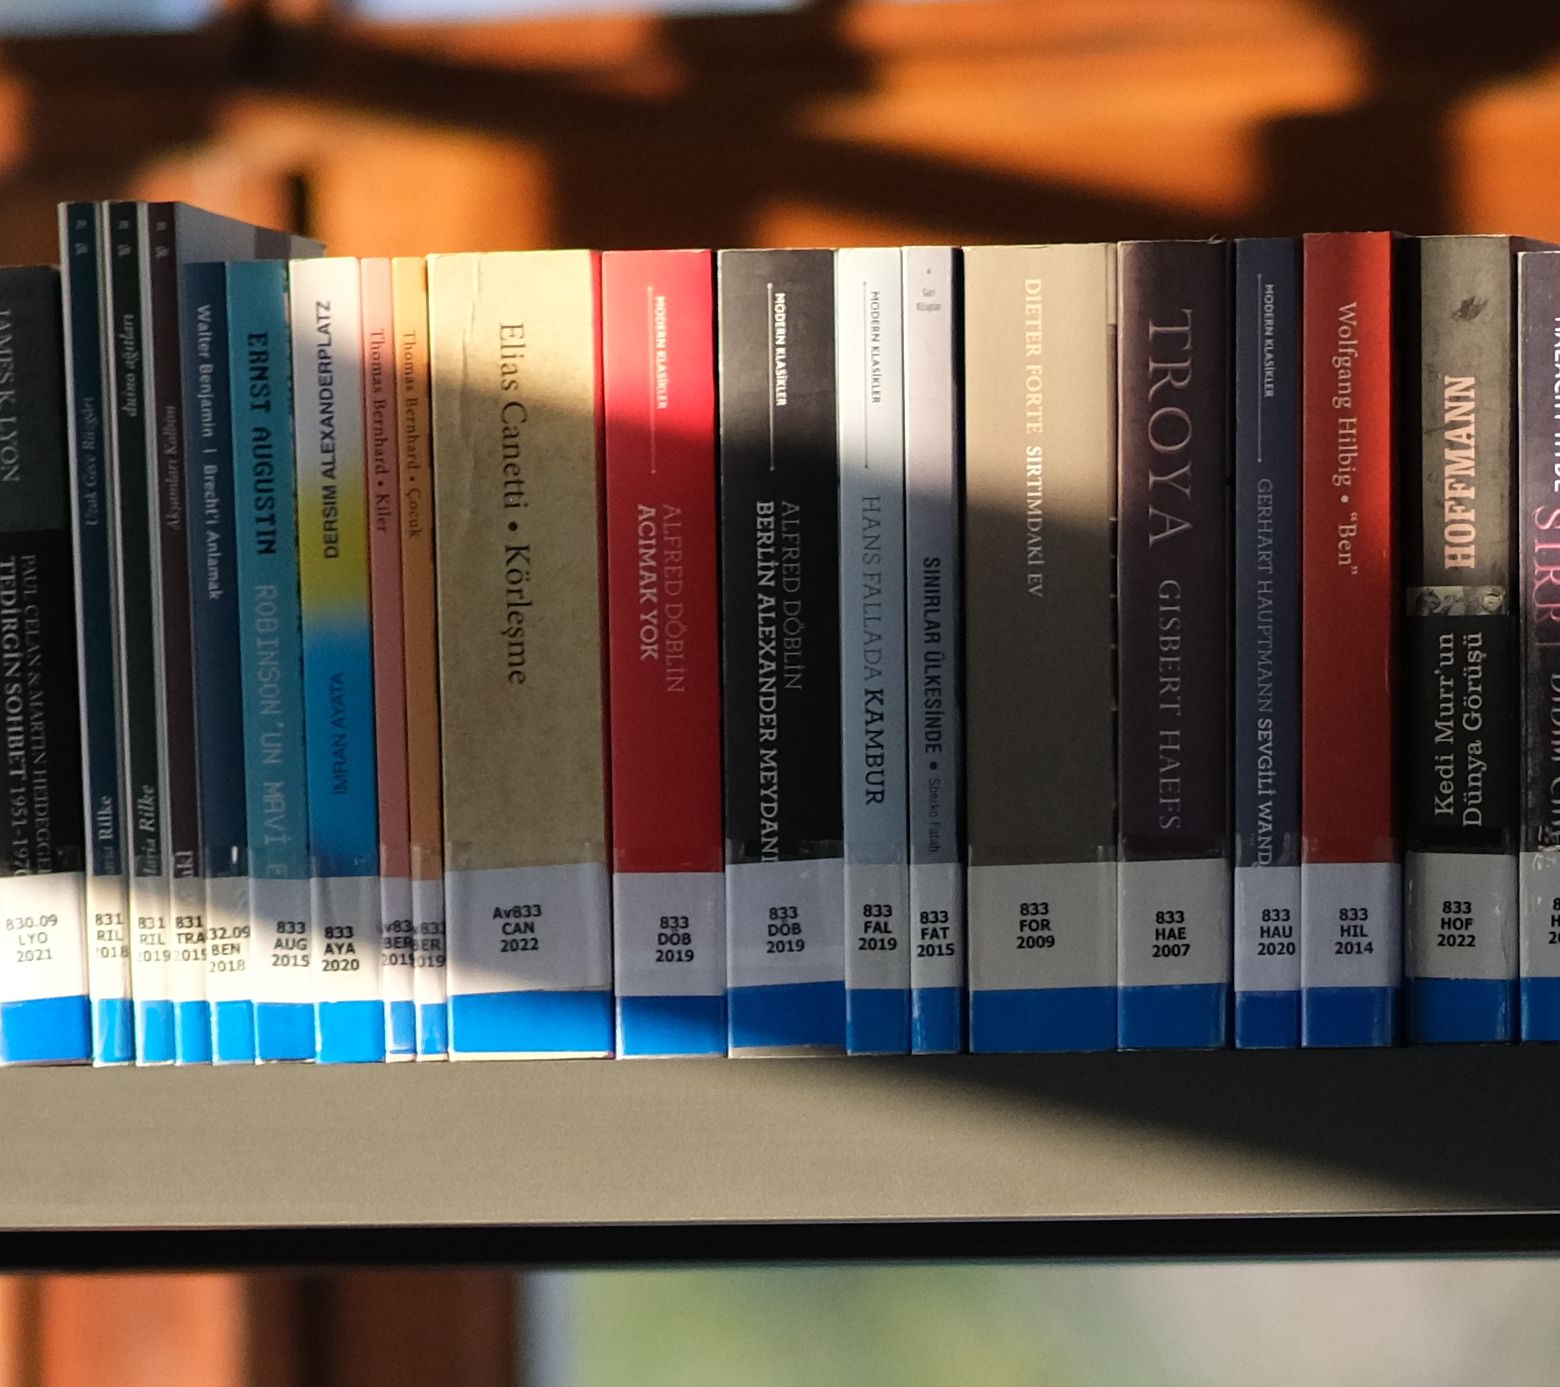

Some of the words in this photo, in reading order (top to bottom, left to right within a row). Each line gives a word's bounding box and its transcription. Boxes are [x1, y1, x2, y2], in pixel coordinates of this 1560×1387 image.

[499, 322, 526, 391] Elias
[1333, 302, 1358, 409] Wolfgang
[500, 401, 528, 511] Canetti
[1146, 308, 1195, 550] TROYA
[1333, 417, 1359, 487] Hilbig
[1444, 374, 1476, 569] HOFFMANN
[637, 504, 659, 605] ACIMAK
[661, 504, 684, 596] ALFRED
[862, 495, 882, 565] HANS
[498, 543, 529, 686] Körleşme
[639, 610, 660, 661] YOK
[863, 572, 883, 681] FALLADA
[923, 557, 945, 644] SINIRLAR
[663, 602, 687, 693] DÖBLİN
[1157, 578, 1184, 717] GISBERT
[1462, 632, 1485, 730] Görüşü
[924, 651, 947, 754] ÜLKESİNDE
[1433, 632, 1456, 744] Murr'un
[4, 682, 28, 780] SOHBET
[864, 688, 886, 805] KAMBUR
[1158, 728, 1184, 831] HAEFS
[1433, 756, 1455, 816] Kedi
[1462, 740, 1485, 827] Dünya
[492, 904, 542, 919] Av833
[502, 921, 535, 935] CAN
[657, 931, 691, 945] DOB
[660, 916, 690, 929] 833
[1017, 935, 1055, 949] 2009
[1020, 902, 1049, 915] 833
[1020, 918, 1051, 932] FOR
[1154, 927, 1186, 940] HAE
[1156, 911, 1185, 924] 833
[1437, 934, 1476, 948] 2022
[1441, 917, 1474, 931] HOF
[1442, 902, 1472, 915] 833
[500, 937, 540, 952] 2022
[655, 949, 694, 962] 2019
[1153, 943, 1190, 957] 2007
